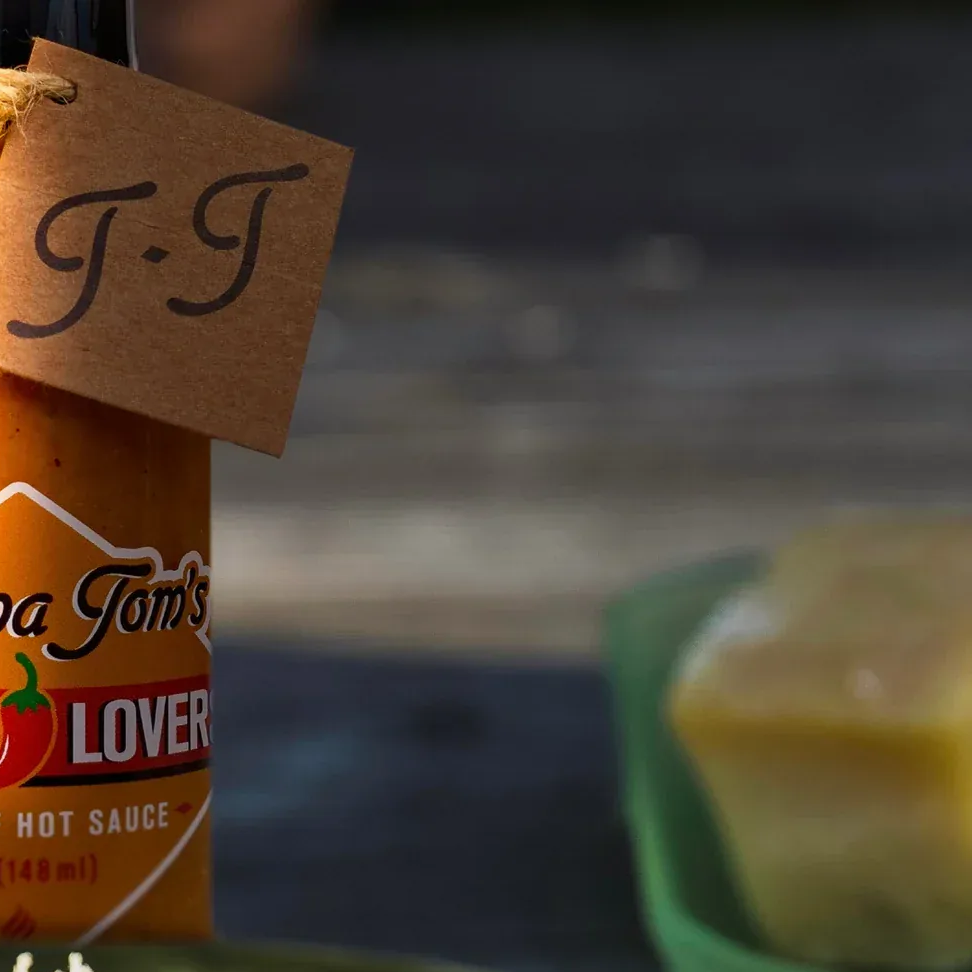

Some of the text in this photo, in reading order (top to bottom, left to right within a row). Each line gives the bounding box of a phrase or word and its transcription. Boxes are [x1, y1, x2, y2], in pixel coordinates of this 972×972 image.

[41, 563, 207, 661] Tom's
[17, 810, 74, 838] HOT
[88, 802, 170, 836] SAUCE
